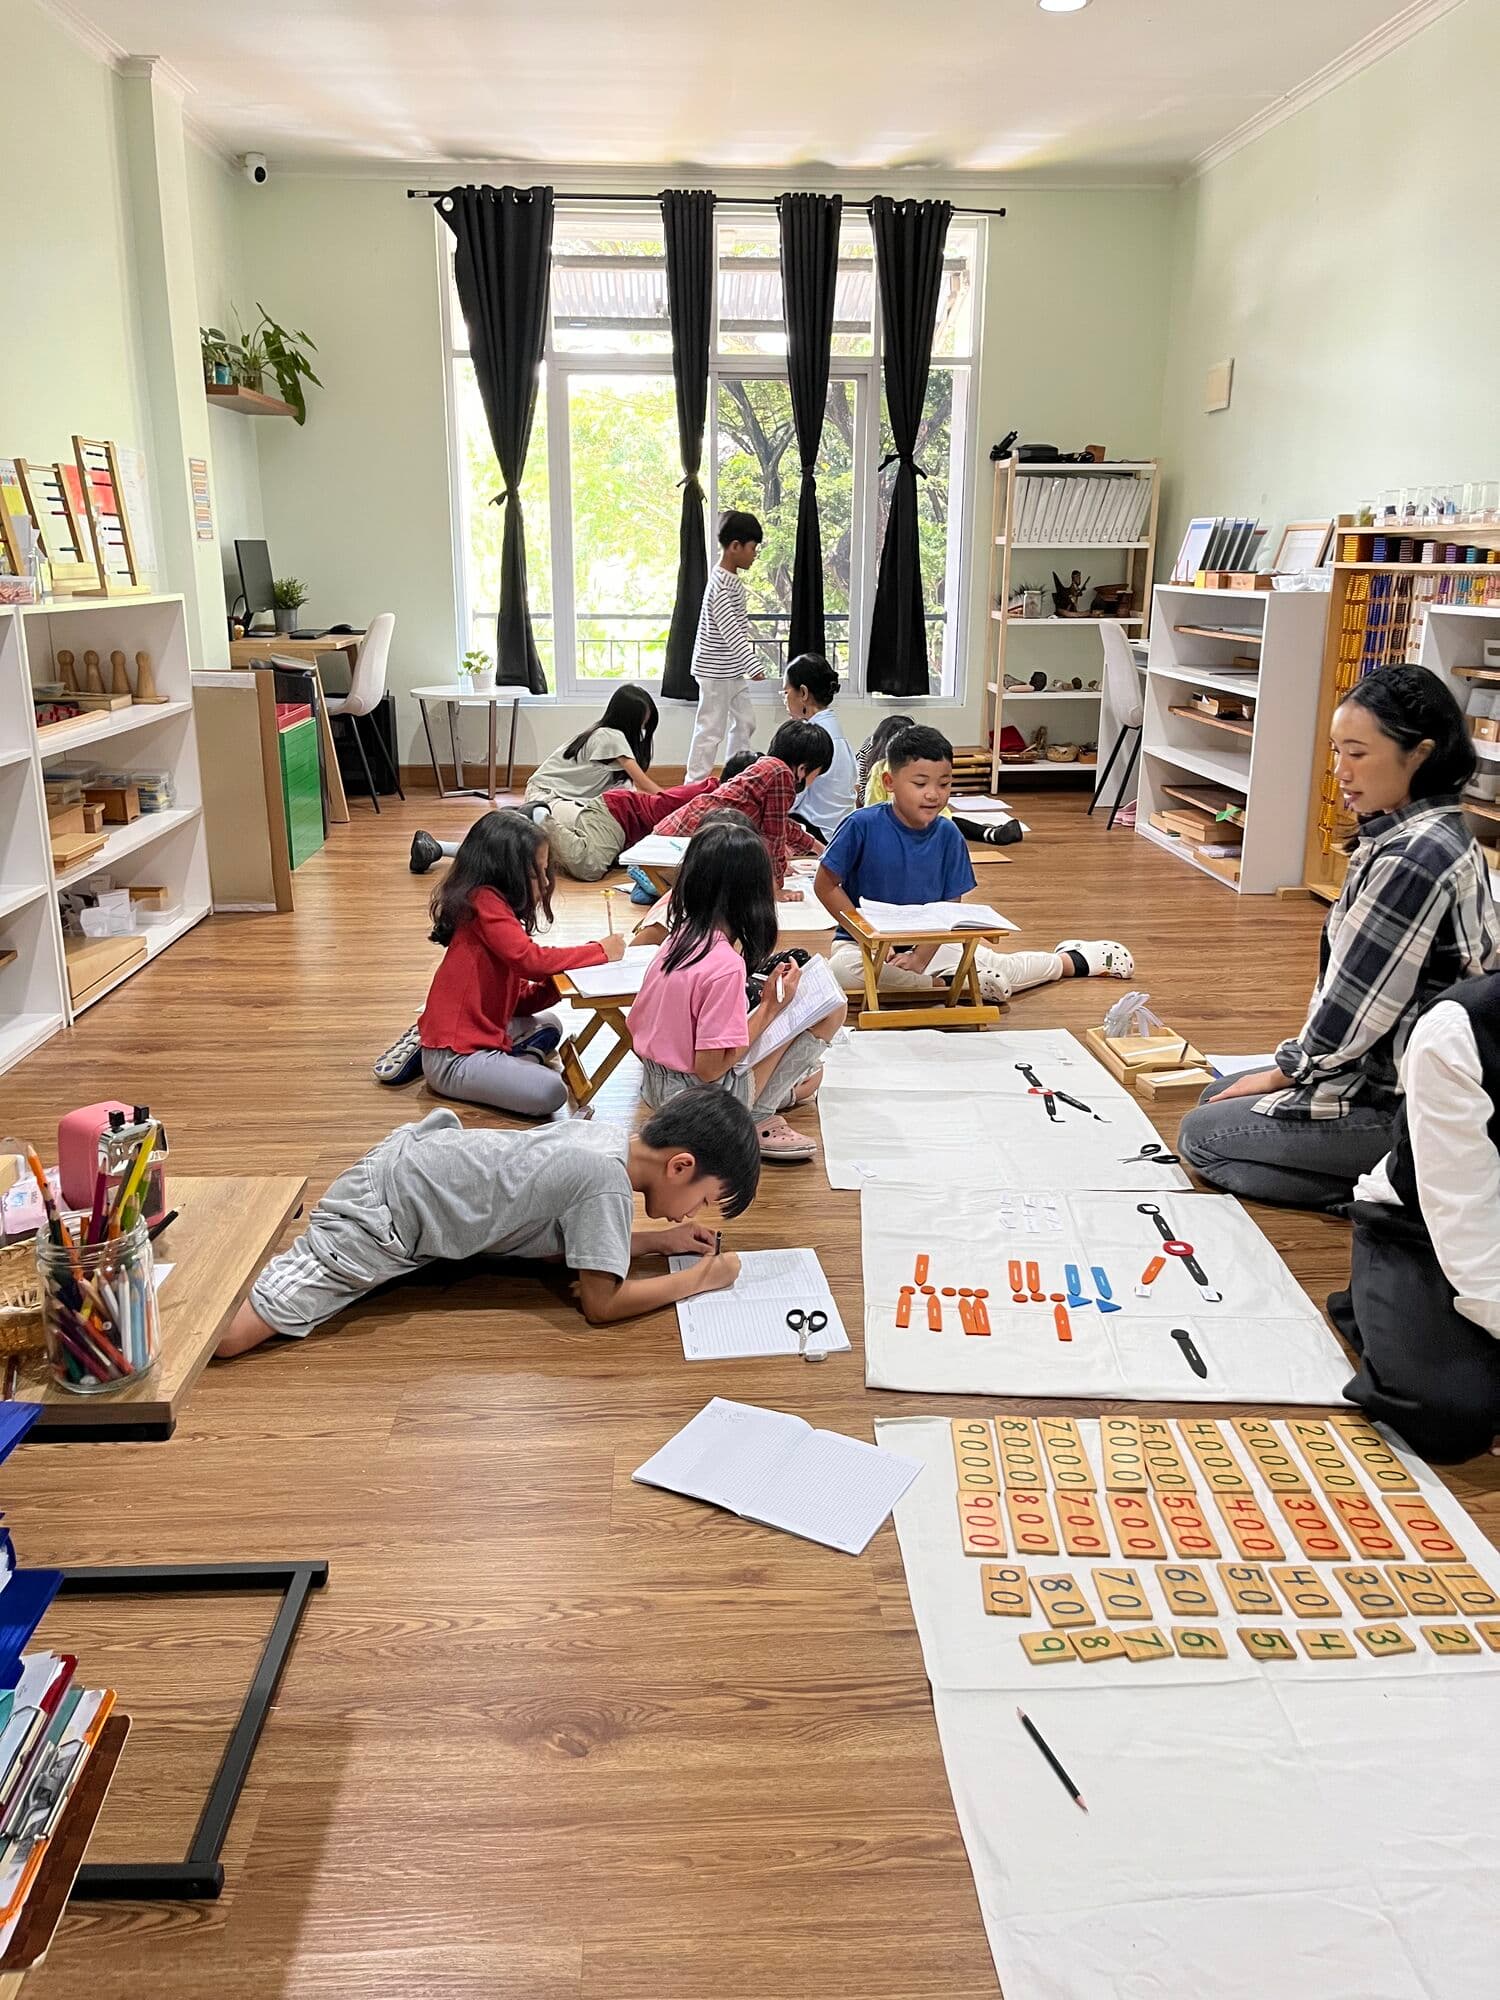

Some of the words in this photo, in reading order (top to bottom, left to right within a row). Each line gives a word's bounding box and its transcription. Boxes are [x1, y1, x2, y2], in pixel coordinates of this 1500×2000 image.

[958, 1424, 994, 1484] 9000
[1000, 1420, 1038, 1482] 8000
[1042, 1421, 1087, 1482] 7000
[1107, 1420, 1142, 1481] 6000
[1139, 1424, 1186, 1484] 5000
[1188, 1424, 1243, 1485] 4000
[1240, 1422, 1299, 1483] 3000
[1295, 1424, 1355, 1486] 2000
[1339, 1423, 1407, 1481] 1000
[964, 1497, 1000, 1546] 900
[1012, 1494, 1049, 1544] 800
[1060, 1495, 1101, 1547] 700
[1114, 1497, 1156, 1549] 600
[1163, 1497, 1211, 1548] 500
[1225, 1499, 1275, 1550] 400
[1284, 1499, 1339, 1550] 300
[1335, 1497, 1393, 1549] 200
[1395, 1503, 1454, 1551] 100
[988, 1569, 1024, 1605] 90
[1040, 1578, 1085, 1614] 80
[1099, 1572, 1142, 1608] 70
[1164, 1568, 1207, 1604] 60
[1228, 1567, 1273, 1604] 50
[1284, 1569, 1330, 1607] 40
[1344, 1571, 1395, 1607] 30
[1396, 1569, 1447, 1605] 20
[1444, 1574, 1496, 1604] 10
[1034, 1637, 1066, 1652] 9
[1080, 1635, 1111, 1649] 8
[1123, 1632, 1164, 1649] 7
[1180, 1631, 1217, 1648] 6
[1250, 1633, 1288, 1649] 5
[1309, 1633, 1345, 1650] 4
[1366, 1629, 1402, 1645] 3
[1431, 1630, 1470, 1644] 2
